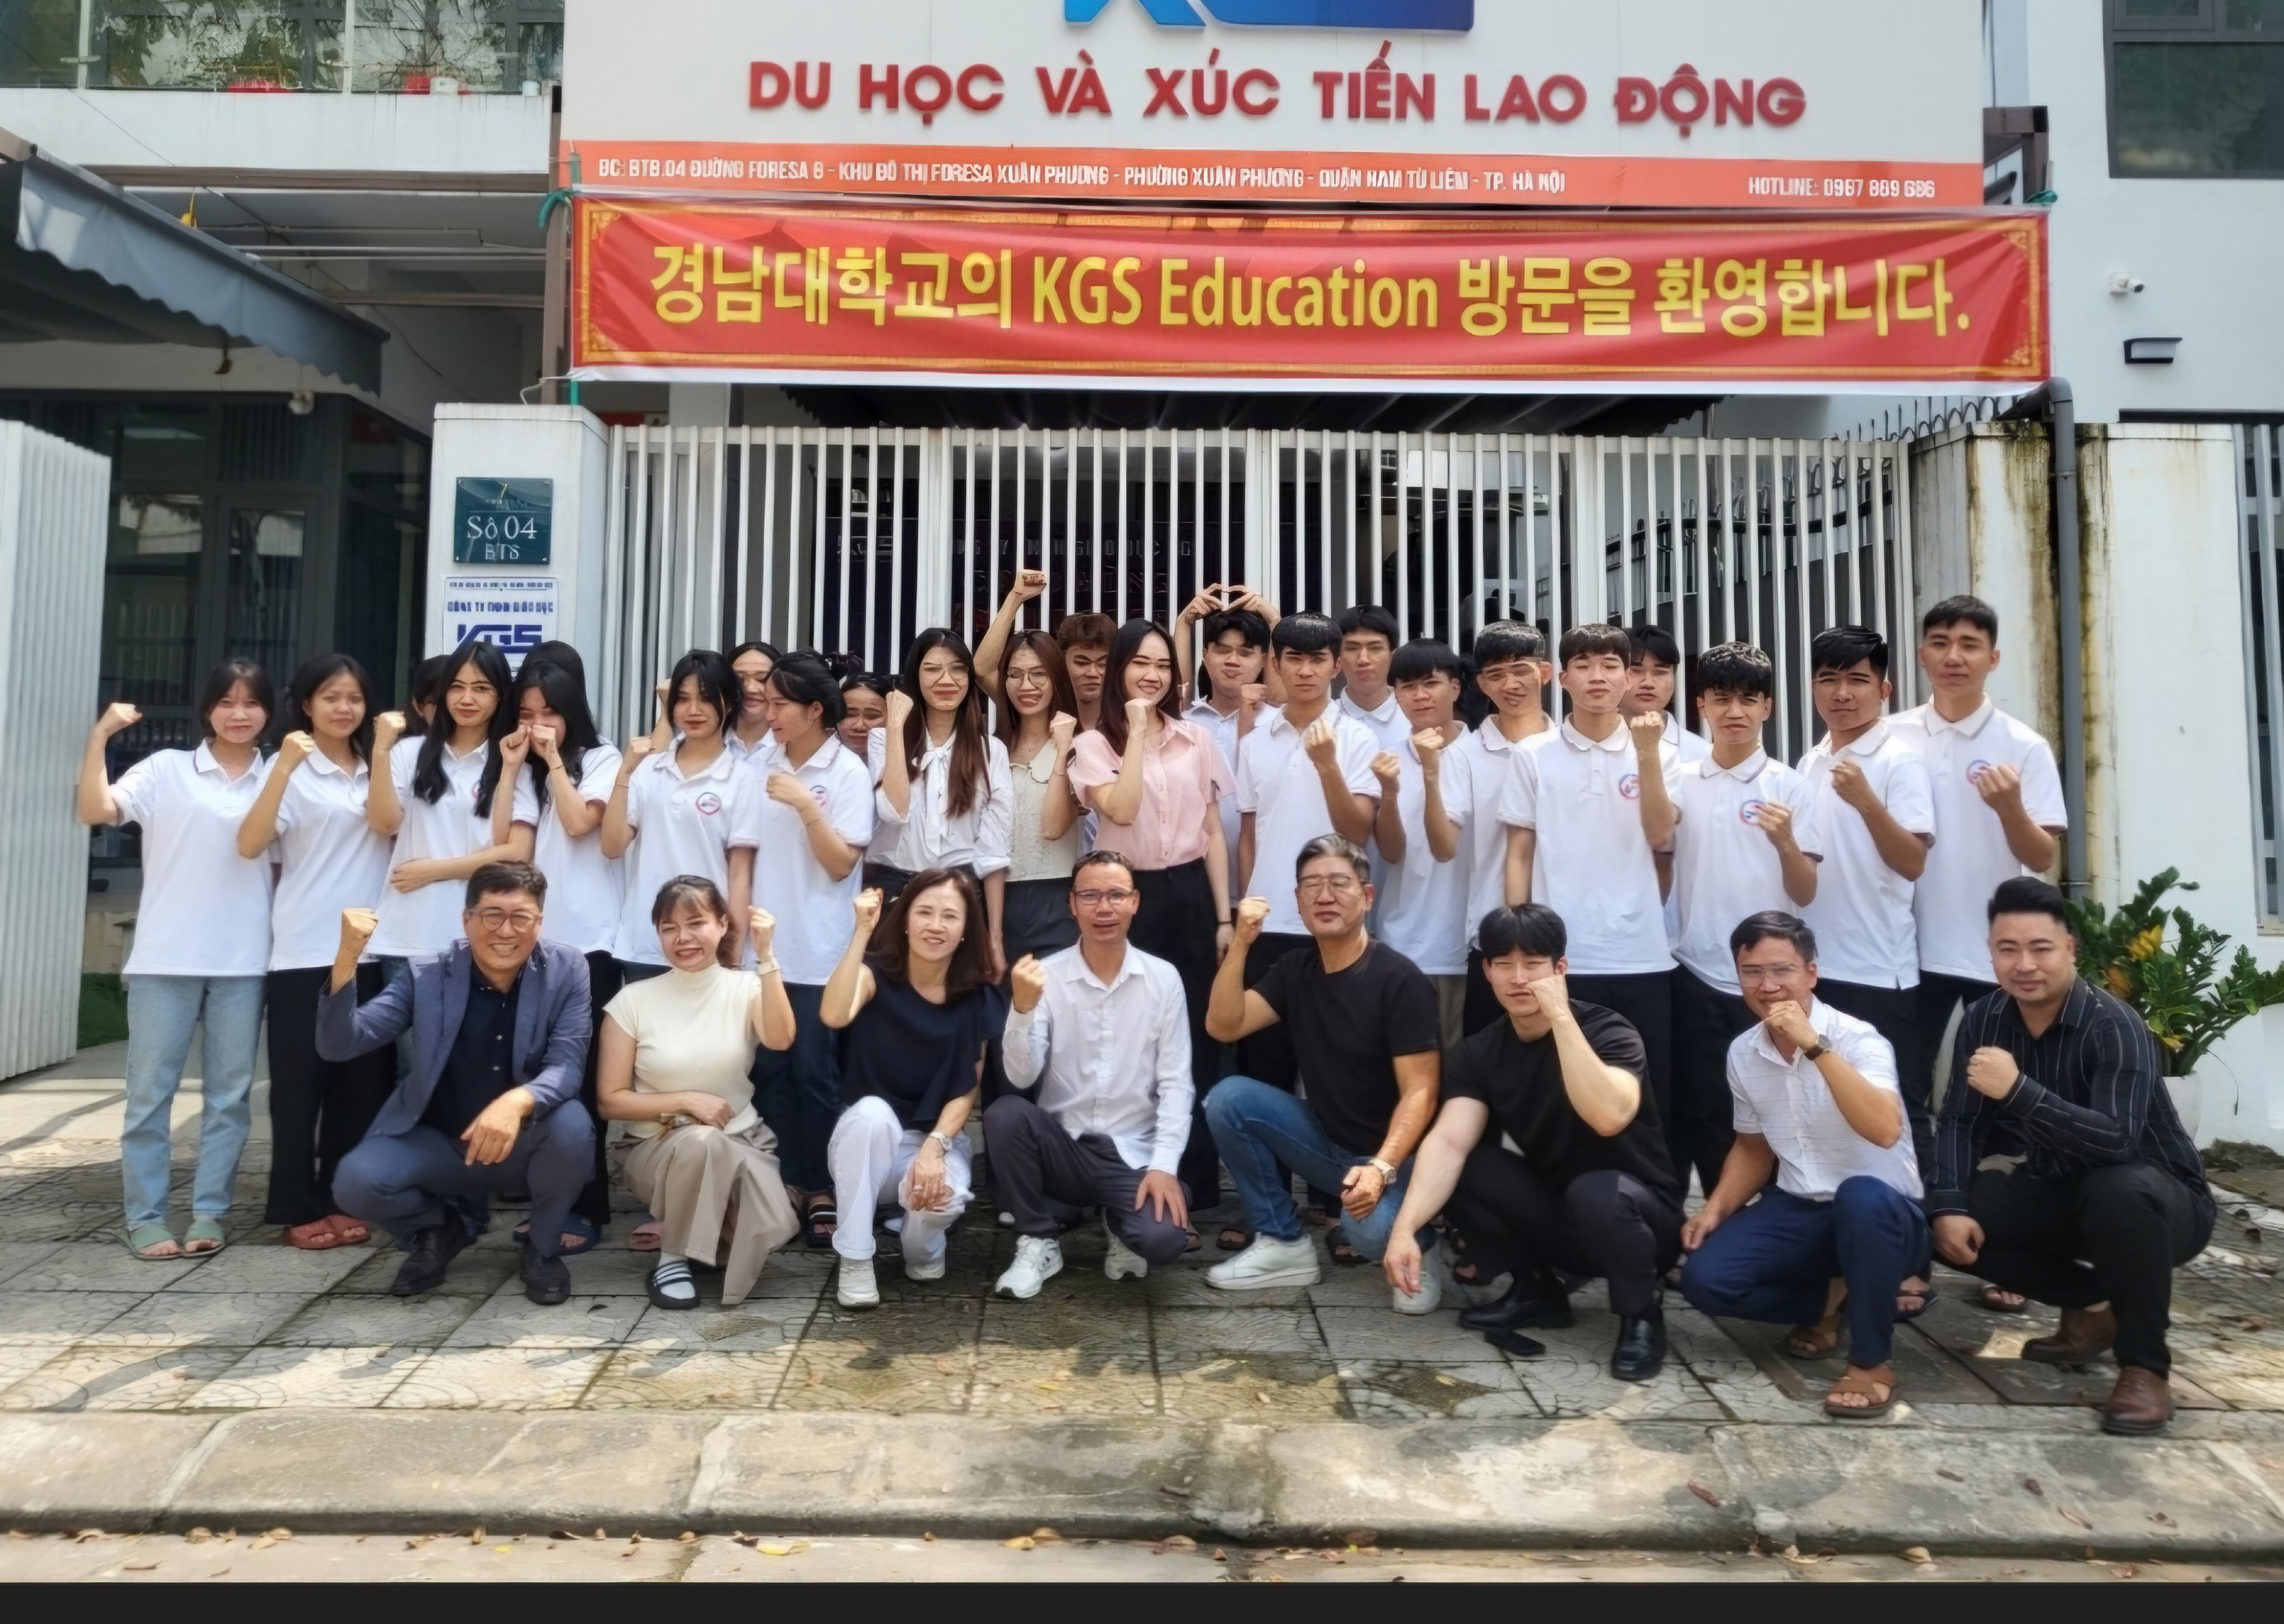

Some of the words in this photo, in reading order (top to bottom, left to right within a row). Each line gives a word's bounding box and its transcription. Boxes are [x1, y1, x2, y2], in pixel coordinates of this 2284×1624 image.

[750, 61, 831, 109] DU
[859, 63, 1005, 125] HỌC
[1036, 49, 1112, 114] VÀ
[1143, 48, 1280, 116] XÚC
[1314, 40, 1435, 120] TIẾN
[1464, 74, 1587, 123] LAO
[1613, 63, 1806, 139] ĐỘNG
[749, 161, 809, 179] FORESA
[838, 162, 873, 181] KHU
[931, 163, 992, 183] FORESA
[651, 243, 1012, 330] 경남대학교의
[1033, 256, 1143, 325] KGS
[1160, 256, 1438, 328] Education
[1458, 255, 1636, 337] 방문을
[1653, 256, 1971, 337] 환영합니다.
[504, 515, 538, 540] 04
